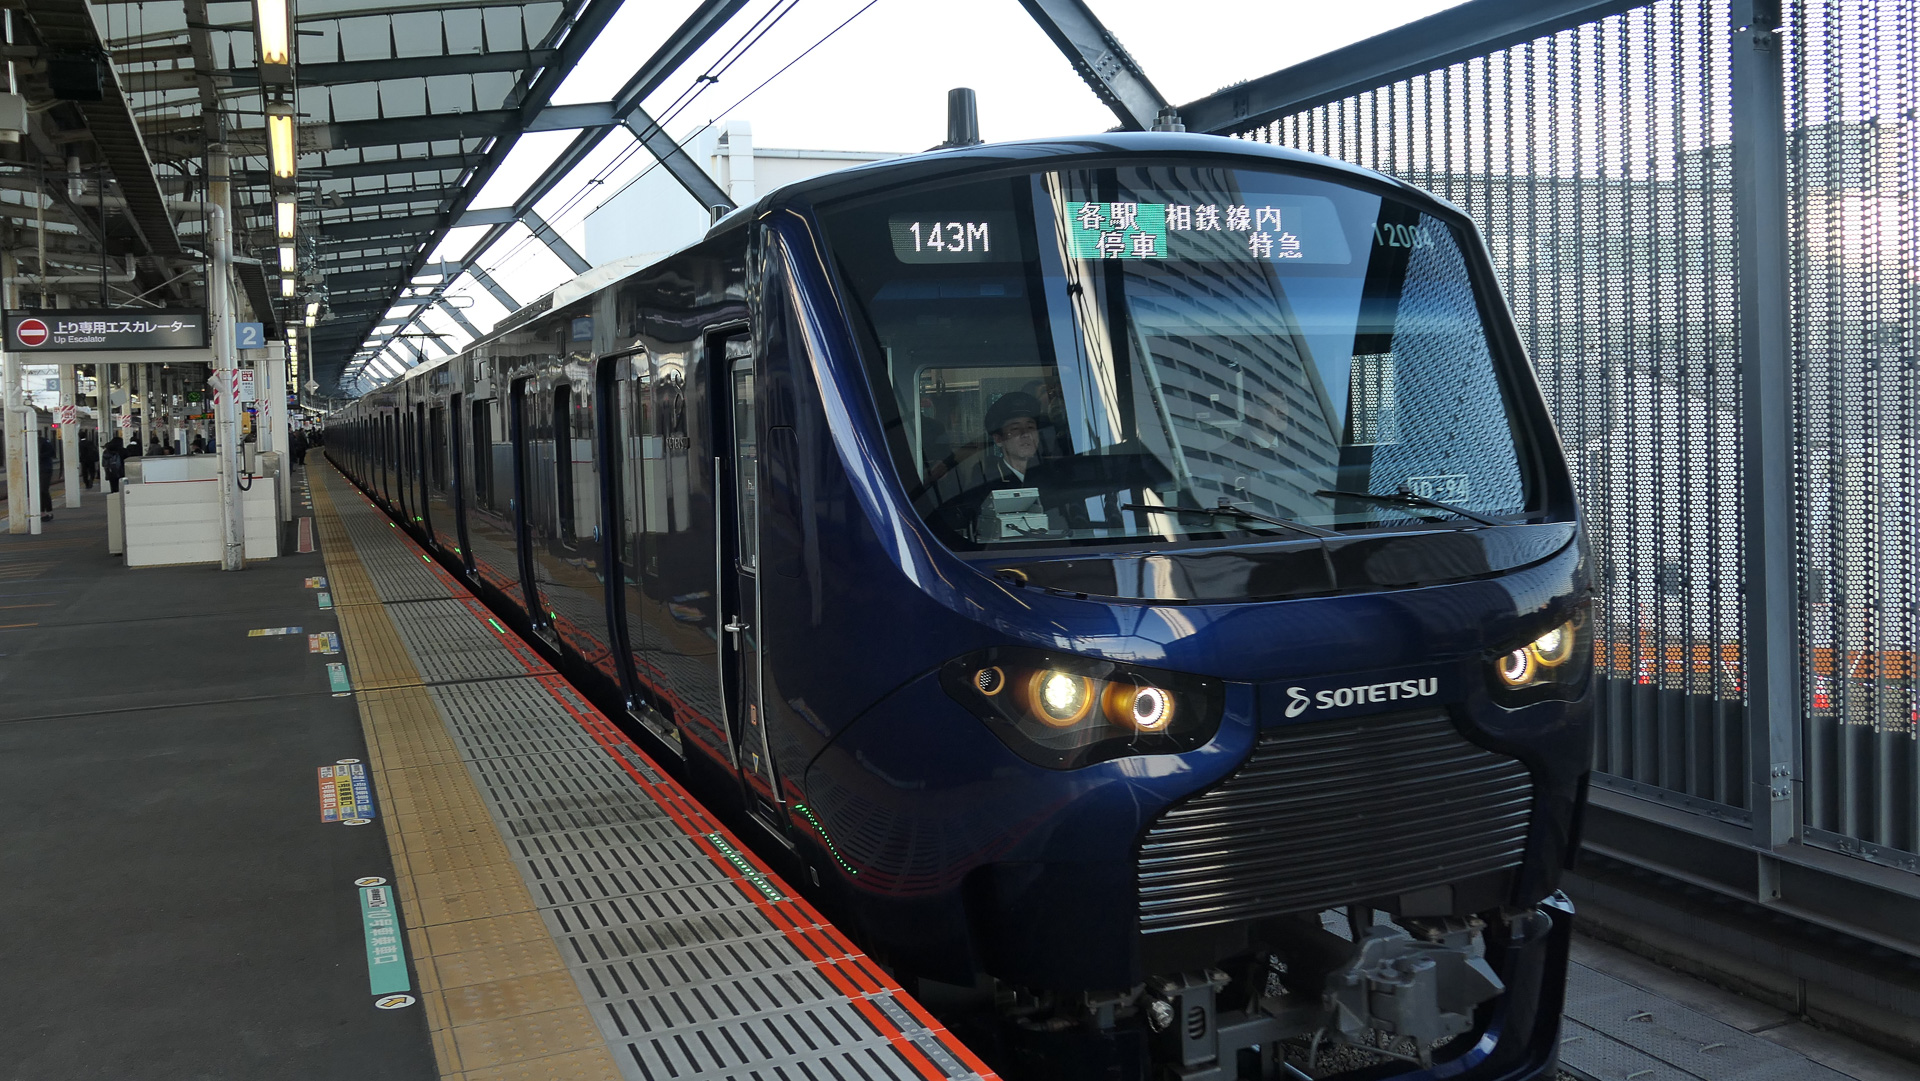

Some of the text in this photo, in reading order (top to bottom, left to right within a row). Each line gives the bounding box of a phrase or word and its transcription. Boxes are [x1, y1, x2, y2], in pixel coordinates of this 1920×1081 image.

[1077, 202, 1282, 232] 各駅 相鉄線内
[910, 222, 989, 252] 143M
[1095, 231, 1304, 259] 停車 特急
[53, 321, 196, 335] 上り専用エスカレーター
[54, 335, 106, 344] Up Escalator
[242, 327, 258, 345] 2
[50, 380, 58, 391] 3
[1315, 677, 1438, 710] SOTETSU
[367, 908, 398, 965] 10号車乗車口
